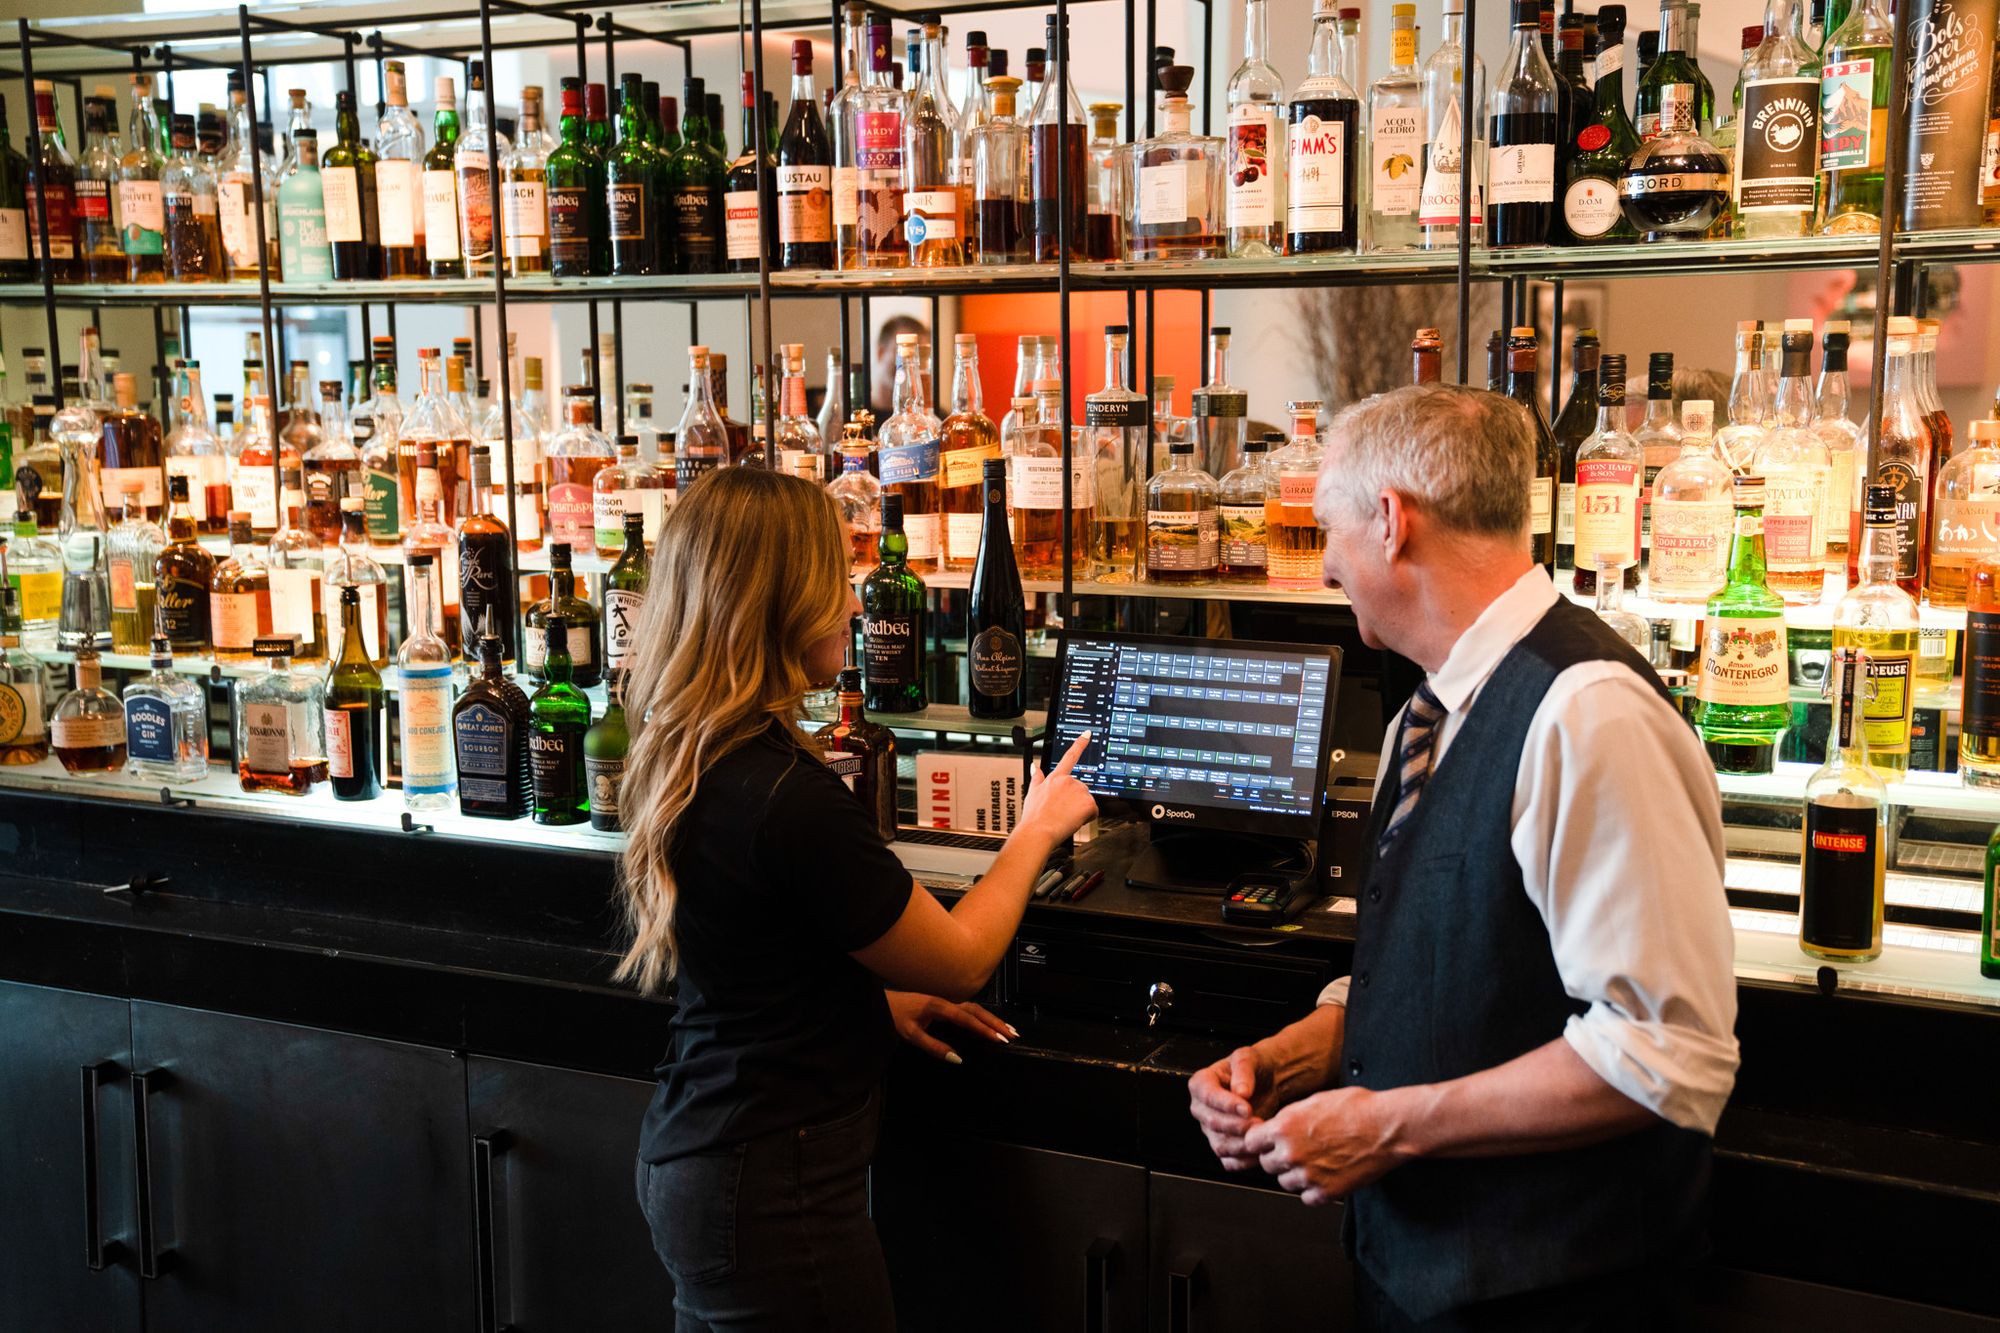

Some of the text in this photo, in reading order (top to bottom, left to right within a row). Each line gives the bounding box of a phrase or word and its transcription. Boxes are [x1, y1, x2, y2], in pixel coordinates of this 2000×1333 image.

[1823, 63, 1862, 79] LPE
[1384, 118, 1415, 127] ACQUA
[861, 127, 894, 136] HARDY
[1384, 126, 1416, 134] CEDRO
[1290, 133, 1337, 156] PIMM'S
[784, 173, 822, 183] USTAU
[1422, 195, 1480, 206] KROGSAD
[1086, 404, 1129, 413] PENDERYN
[1578, 463, 1634, 473] LEMON HART
[596, 497, 623, 507] udson
[1659, 537, 1706, 548] DON PAPA
[1706, 657, 1779, 680] MONTENEGRO
[1866, 664, 1907, 676] TREUSE
[131, 714, 165, 727] BOODLES
[250, 726, 285, 738] DISARONNO
[458, 723, 503, 733] GREAT JONES
[142, 730, 156, 739] GIN
[463, 743, 499, 753] BOURBON
[931, 772, 951, 829] NING
[991, 780, 1001, 832] BEVERAGES
[1006, 777, 1016, 834] GNANCY CAN
[976, 808, 986, 831] KING
[1165, 809, 1195, 820] SpotOn
[1332, 810, 1359, 819] EPSON
[1815, 834, 1864, 849] INTENSE
